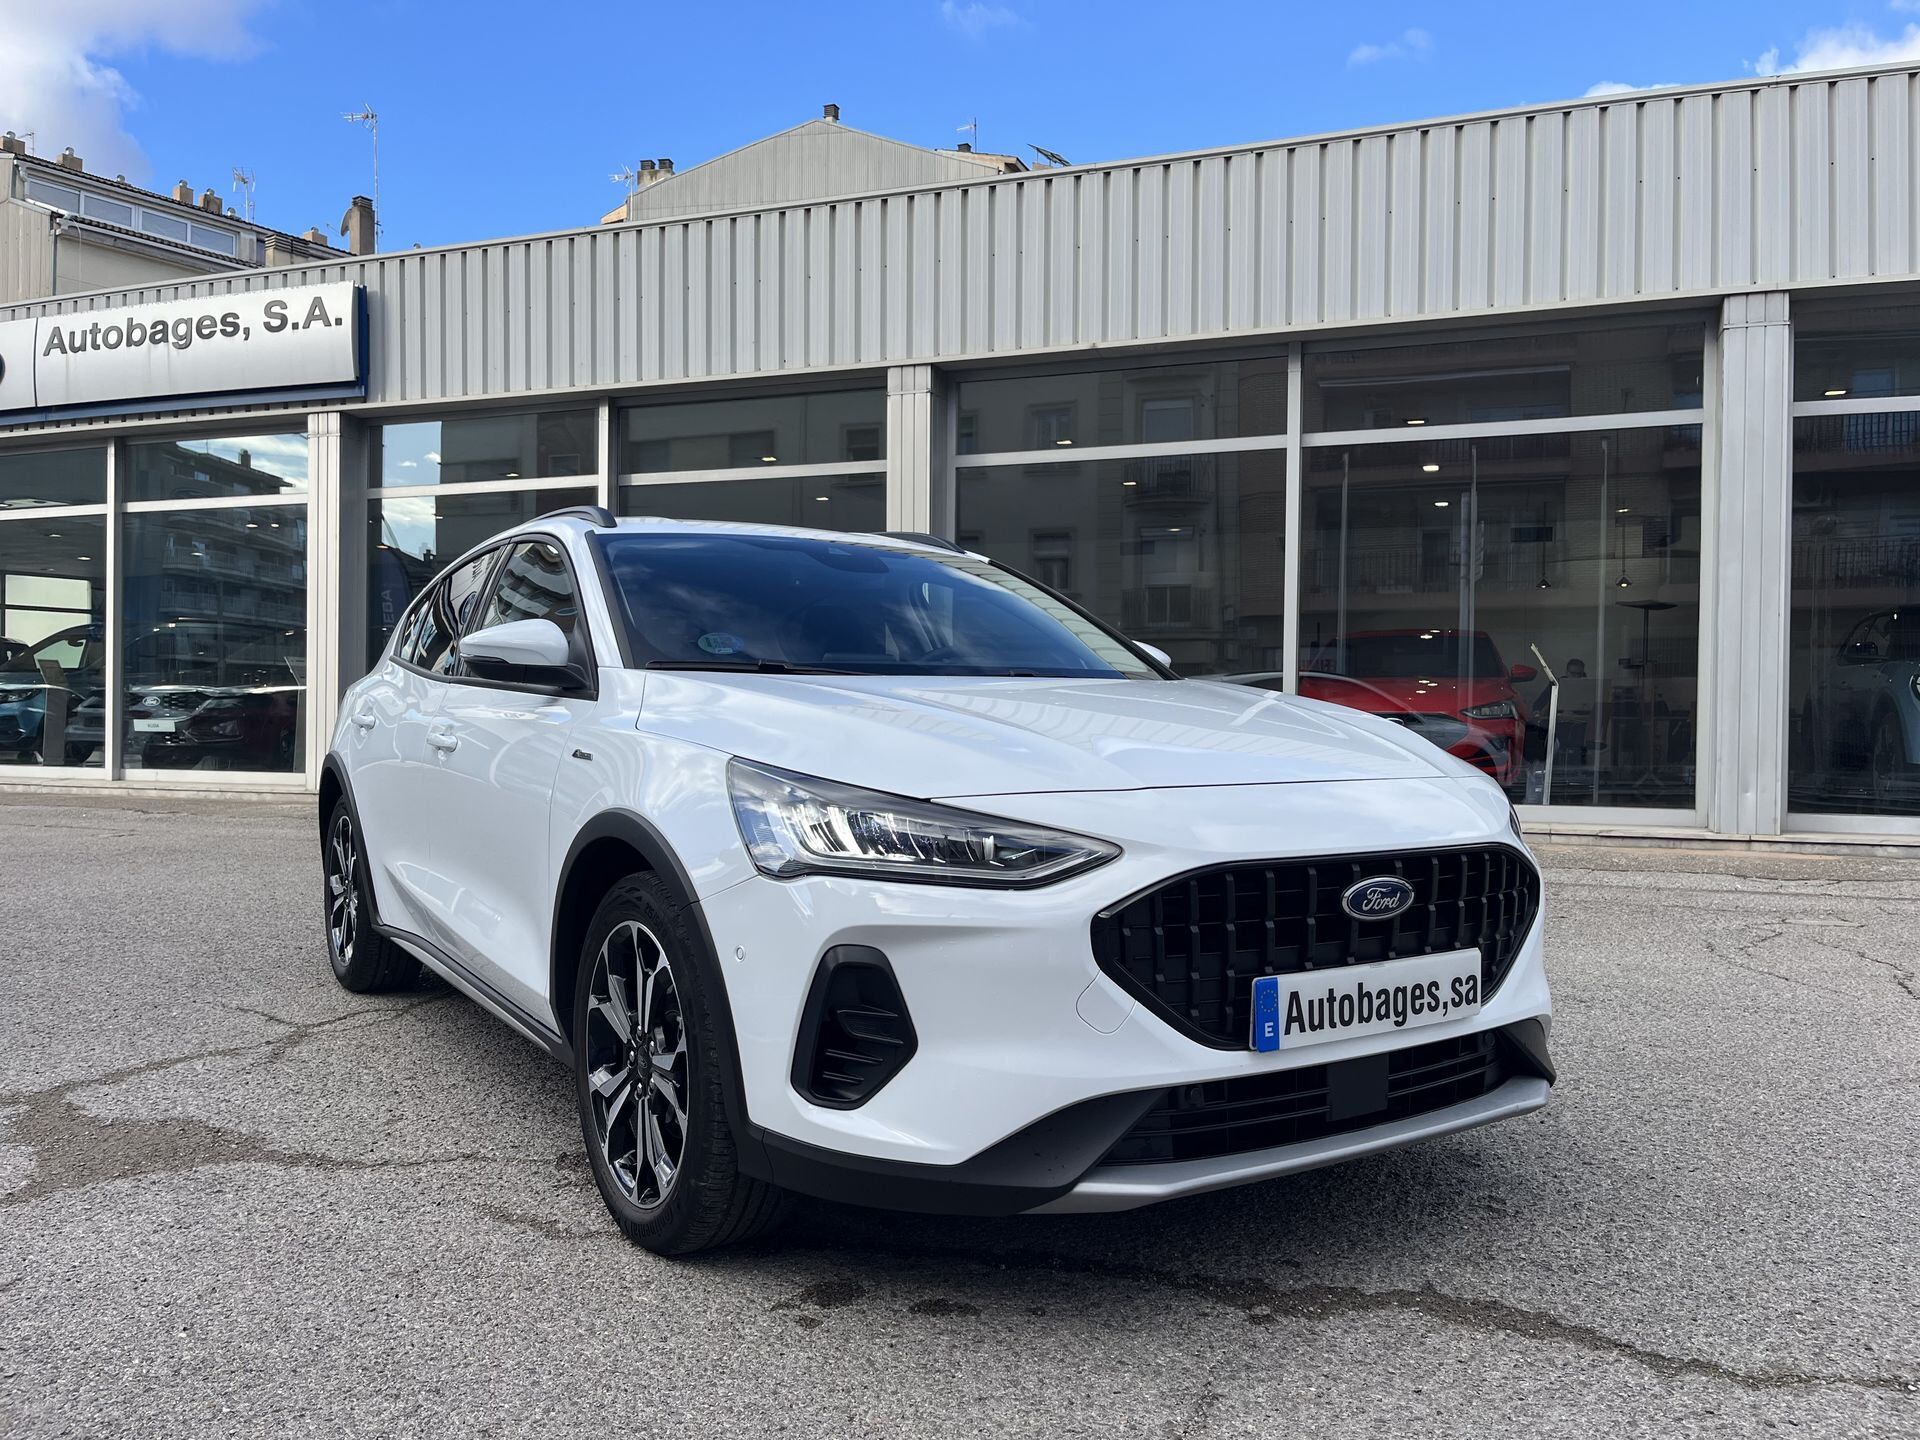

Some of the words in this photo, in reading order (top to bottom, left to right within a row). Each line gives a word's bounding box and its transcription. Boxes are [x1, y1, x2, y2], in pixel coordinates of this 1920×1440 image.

[43, 312, 251, 356] Autobages,
[263, 296, 343, 332] S.A.
[1362, 886, 1401, 910] Ford
[1284, 974, 1478, 1035] Autobages,sa
[1264, 1022, 1275, 1038] E
